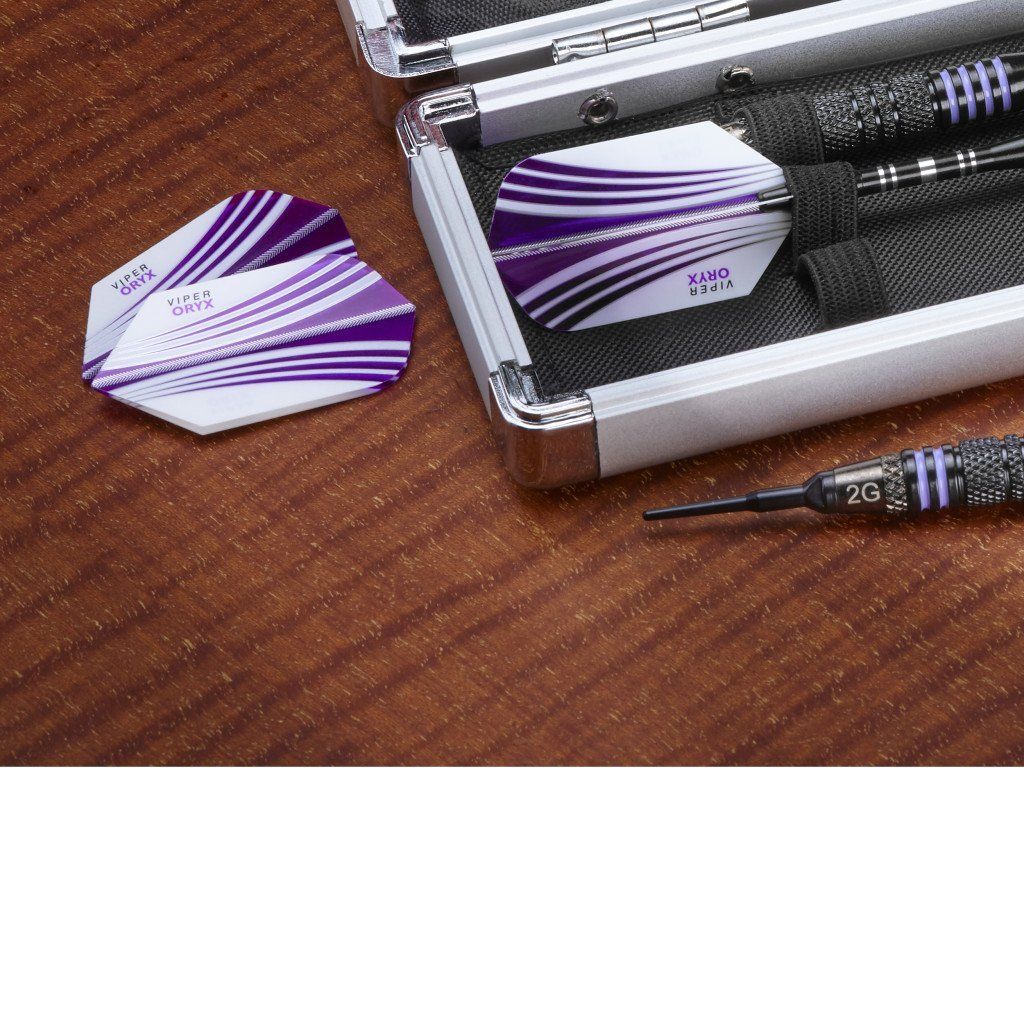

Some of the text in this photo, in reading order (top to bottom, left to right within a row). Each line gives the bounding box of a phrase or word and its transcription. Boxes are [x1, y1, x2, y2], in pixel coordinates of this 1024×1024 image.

[110, 263, 149, 290] VIPER
[120, 269, 157, 296] ORYX
[688, 267, 730, 286] ORYX
[690, 279, 734, 296] VIPER
[167, 290, 211, 306] VIPER
[172, 298, 214, 316] ORYX
[846, 482, 880, 504] 2G
